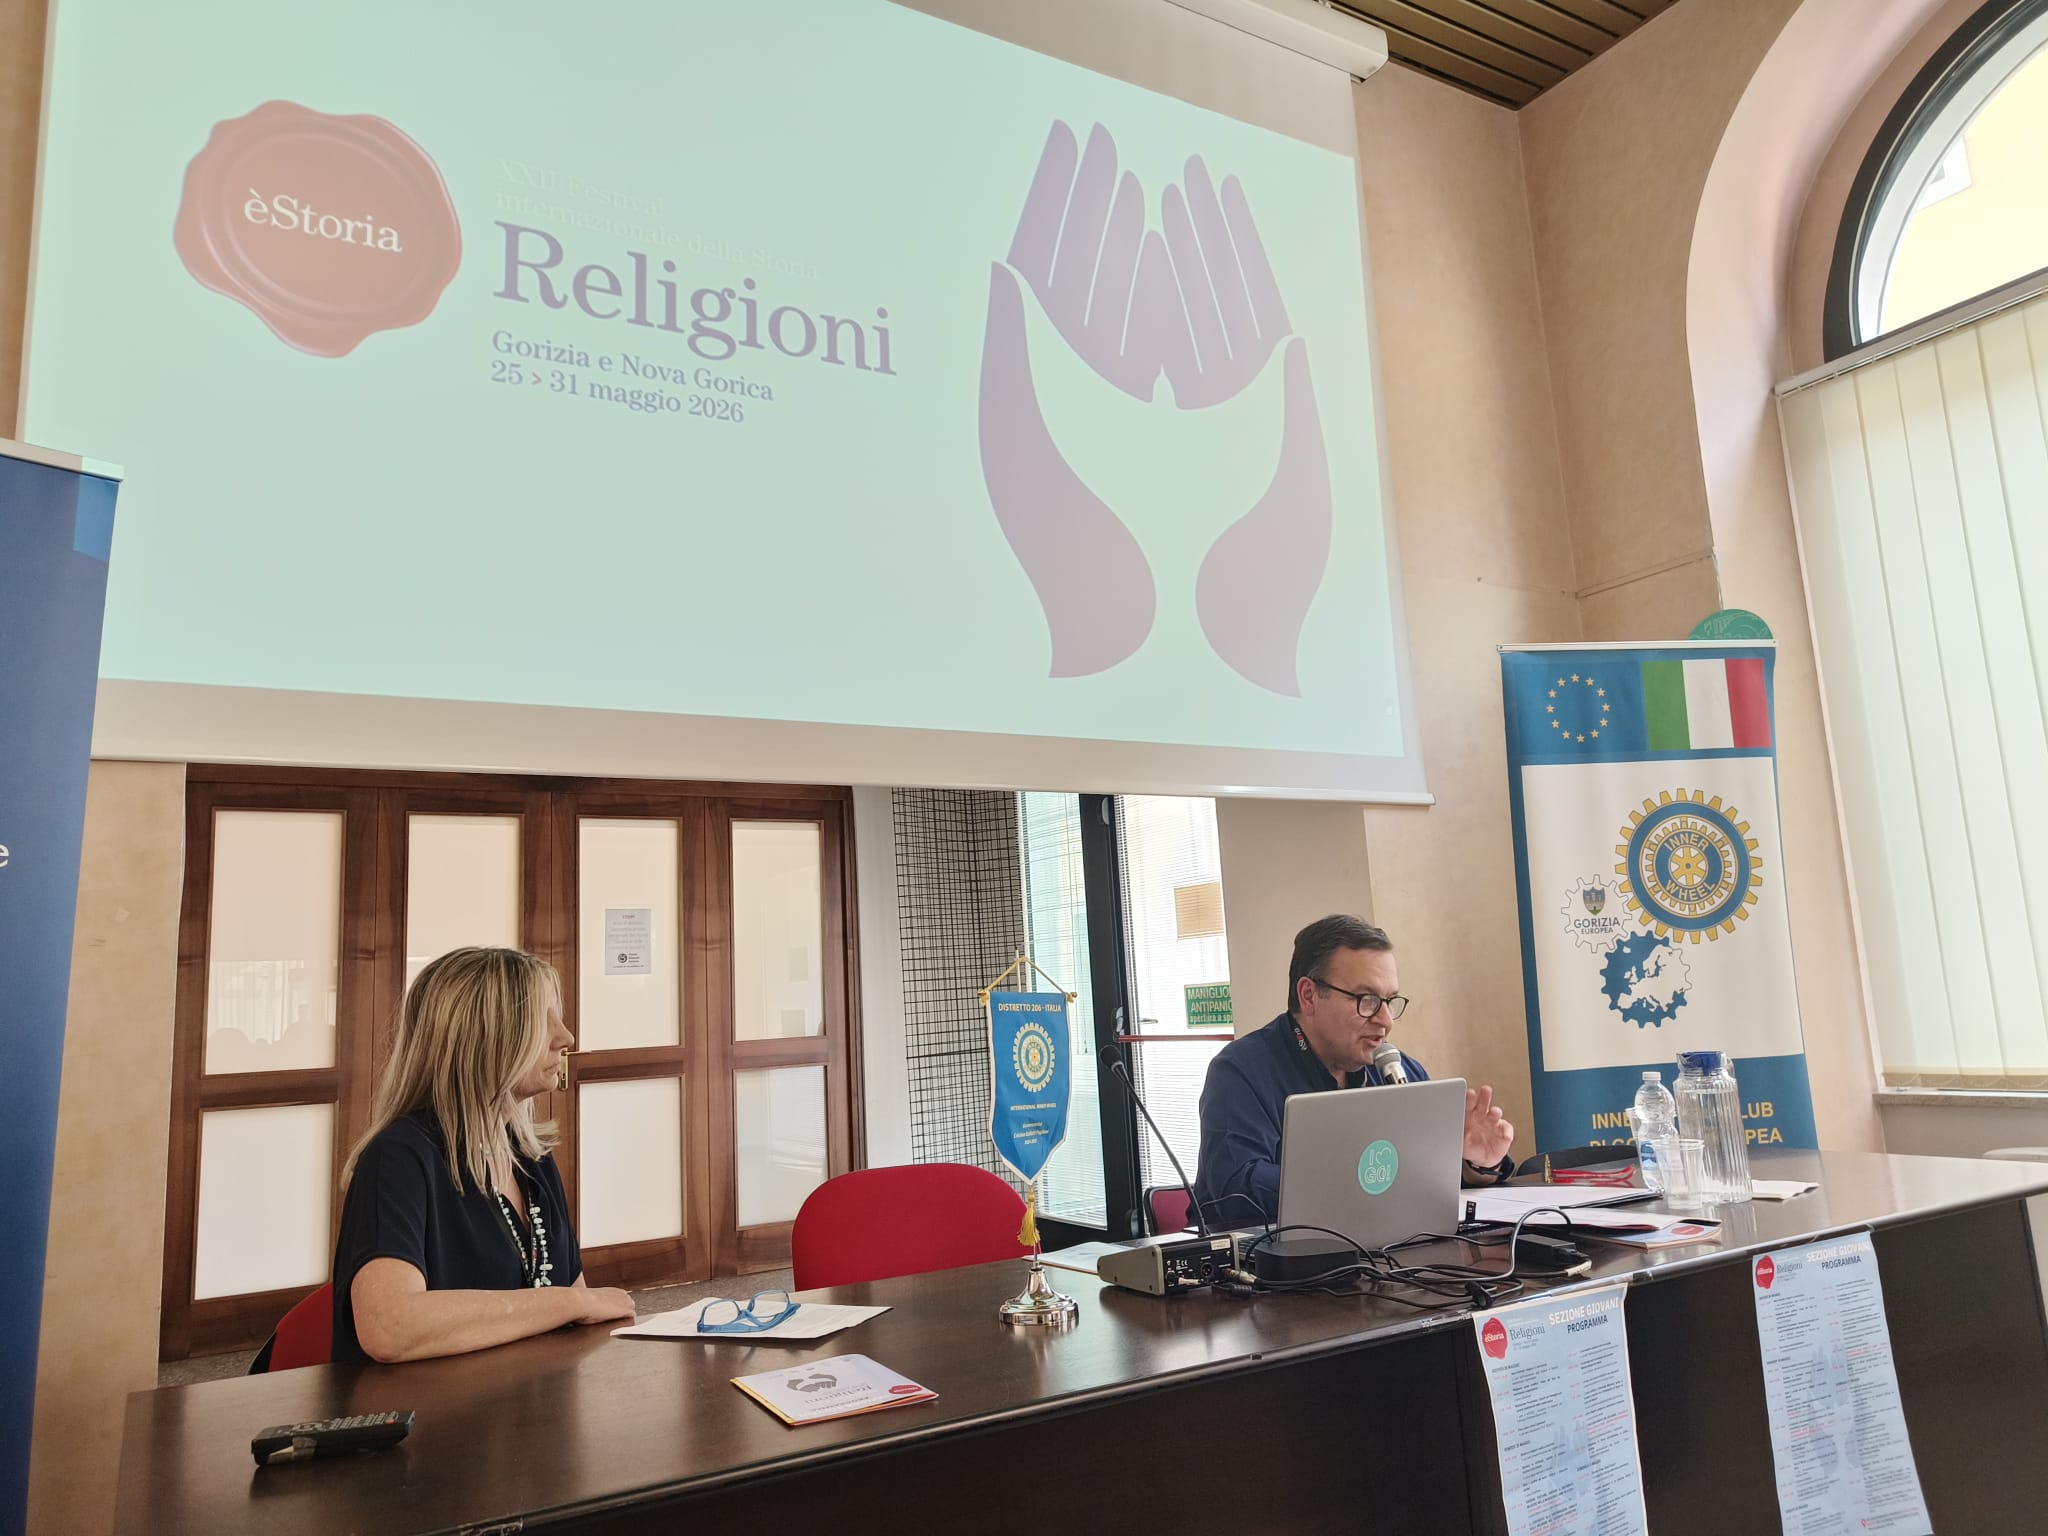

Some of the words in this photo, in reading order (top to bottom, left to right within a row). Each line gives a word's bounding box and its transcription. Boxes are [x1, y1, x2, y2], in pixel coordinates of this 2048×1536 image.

[567, 174, 664, 218] Festival
[243, 186, 402, 253] èStoria
[494, 184, 681, 248] internazionale
[687, 232, 744, 265] della
[752, 244, 818, 281] Storia
[493, 219, 898, 377] Religioni
[491, 329, 591, 369] Gorizia
[598, 354, 614, 372] e
[621, 352, 687, 387] Nova
[692, 367, 775, 402] Gorica
[490, 360, 525, 386] 25
[549, 369, 580, 397] 31
[588, 377, 682, 416] maggio
[688, 393, 745, 424] 2026
[1664, 833, 1709, 851] INNER
[1665, 879, 1716, 901] WHEEL
[1573, 916, 1620, 929] GORIZIA
[1580, 926, 1614, 936] EUROPEA
[998, 1003, 1031, 1012] DISTRETTO
[1045, 1004, 1062, 1012] ITALIA
[1807, 1247, 1839, 1262] SEZIONE
[1821, 1255, 1862, 1270] PROGRAMMA
[1548, 1306, 1585, 1326] SEZIONE
[1586, 1297, 1619, 1315] GIOVANI
[1509, 1323, 1546, 1341] Religioni
[1567, 1314, 1609, 1334] PROGRAMMA
